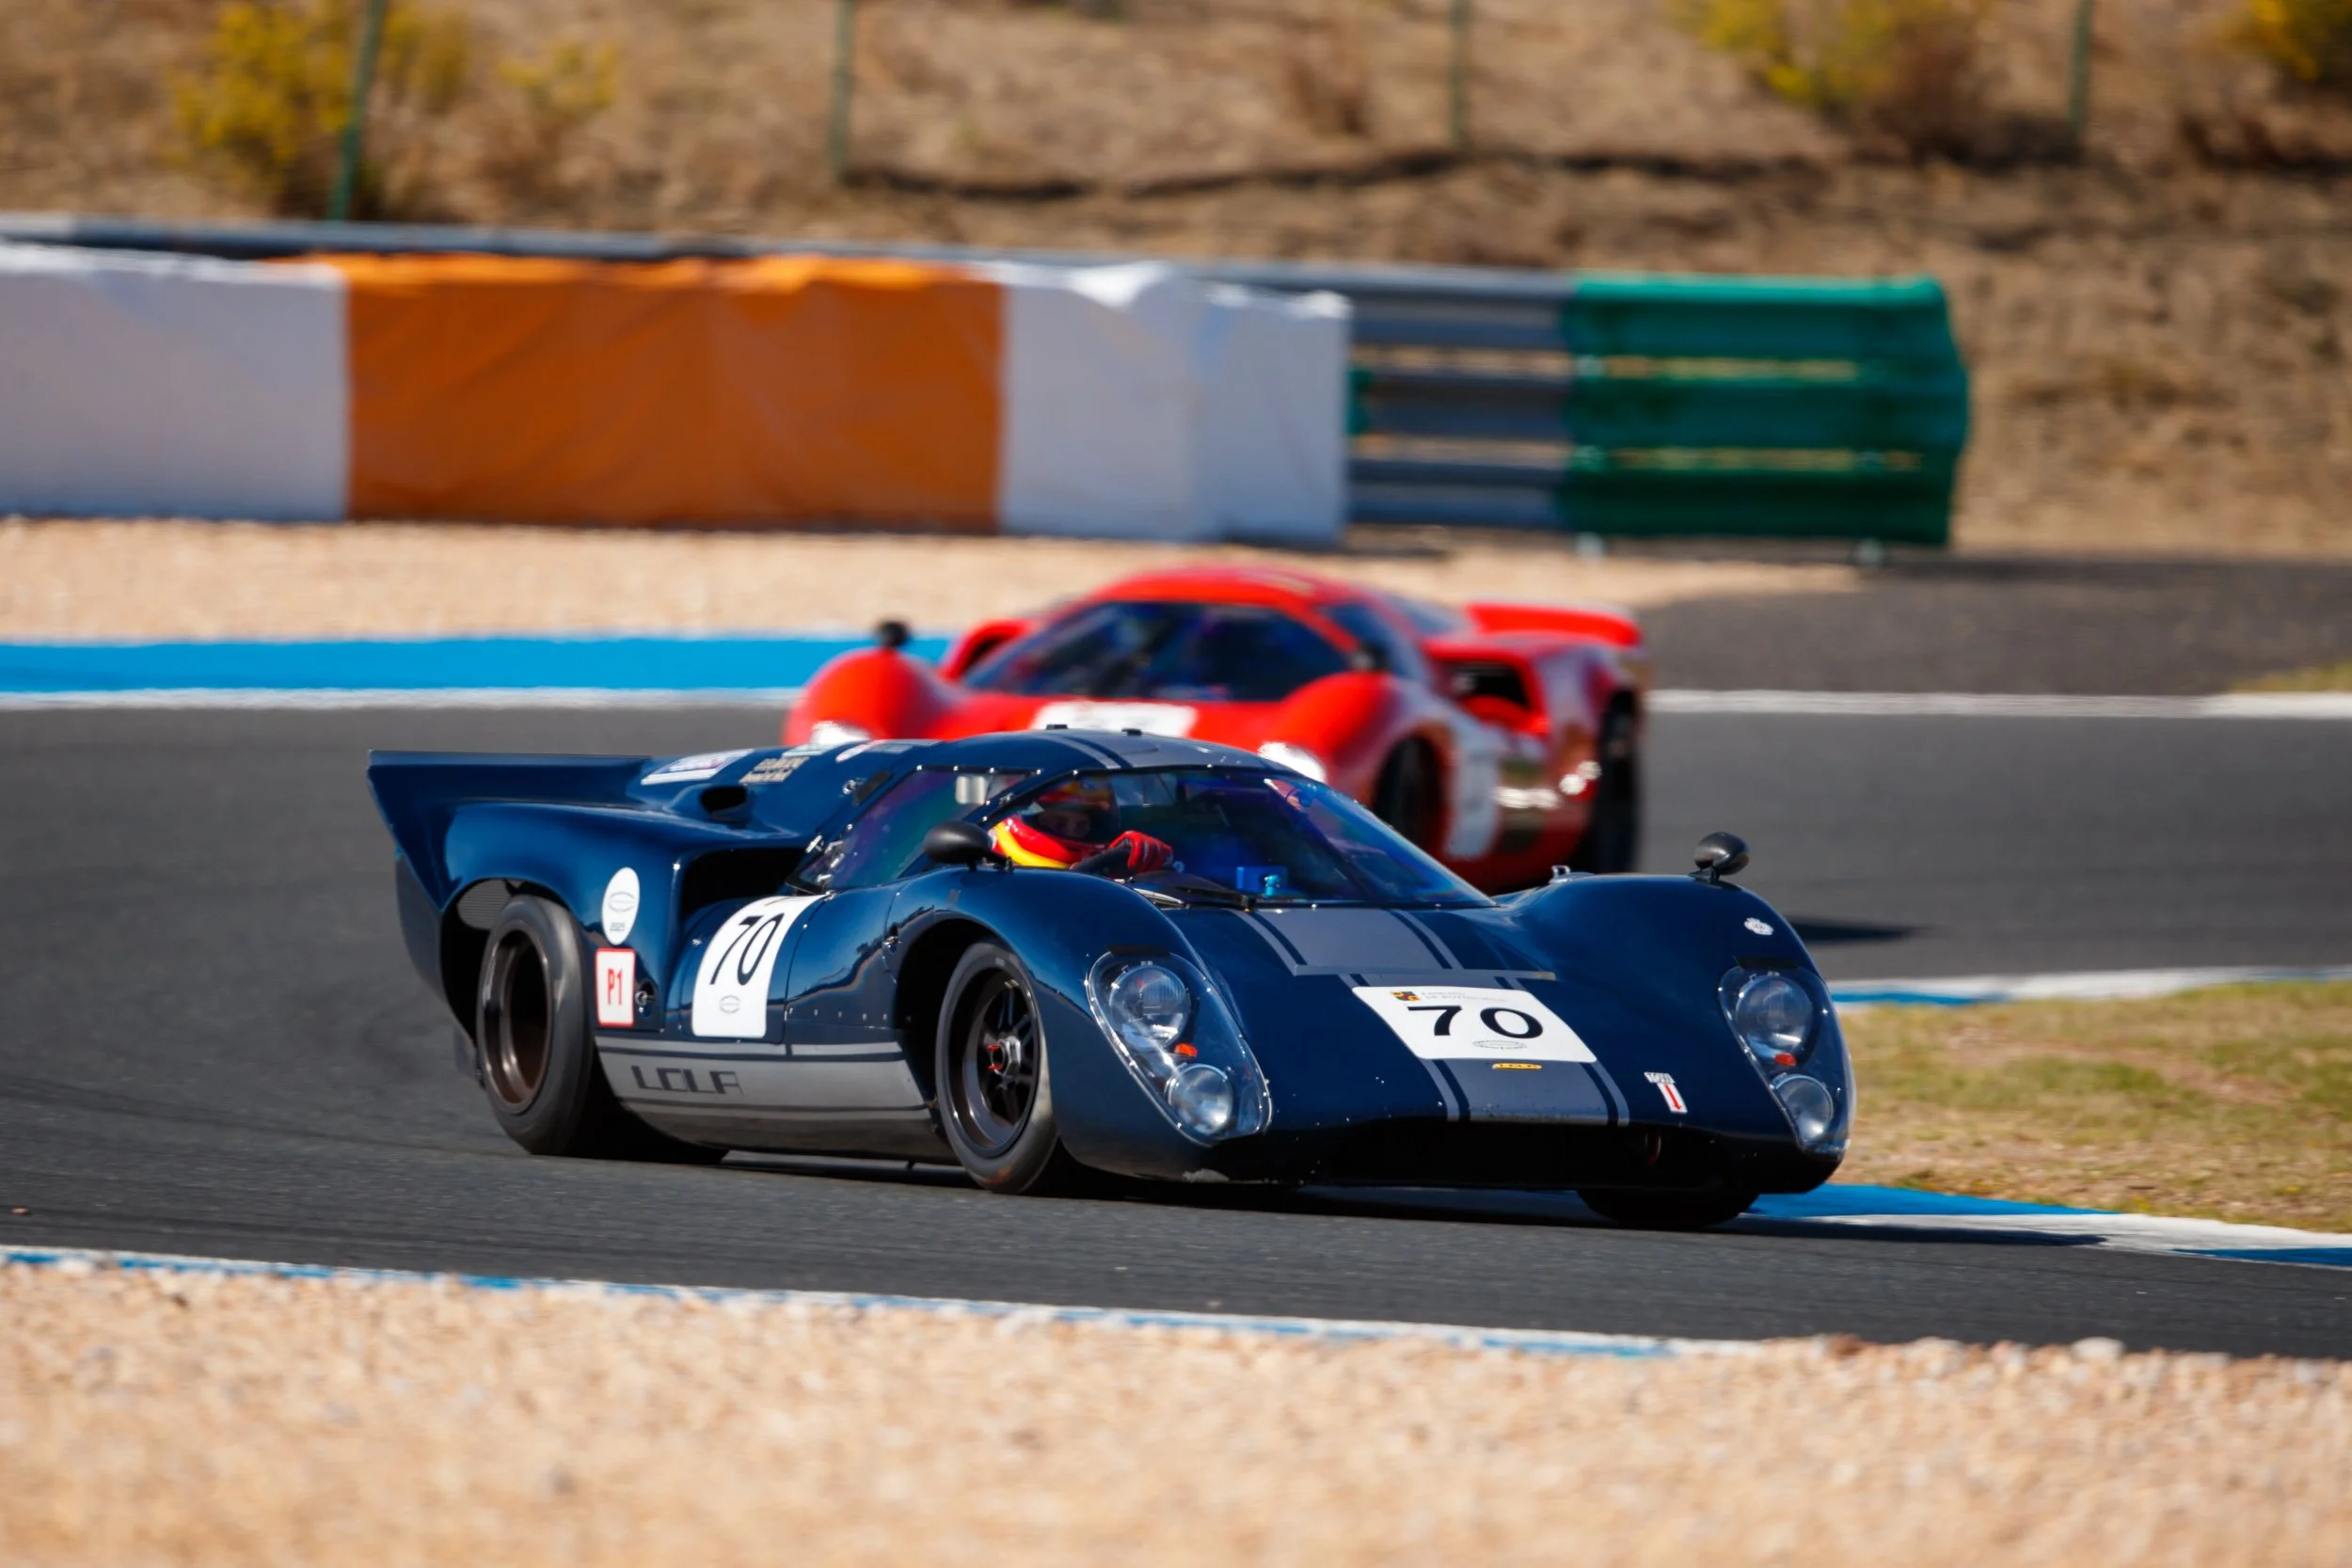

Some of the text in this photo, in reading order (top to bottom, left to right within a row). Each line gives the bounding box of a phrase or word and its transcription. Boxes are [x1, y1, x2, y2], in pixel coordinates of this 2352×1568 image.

[709, 912, 785, 986] 70
[607, 967, 623, 1006] P1
[1407, 1005, 1543, 1039] 70
[630, 1065, 744, 1096] LOLA
